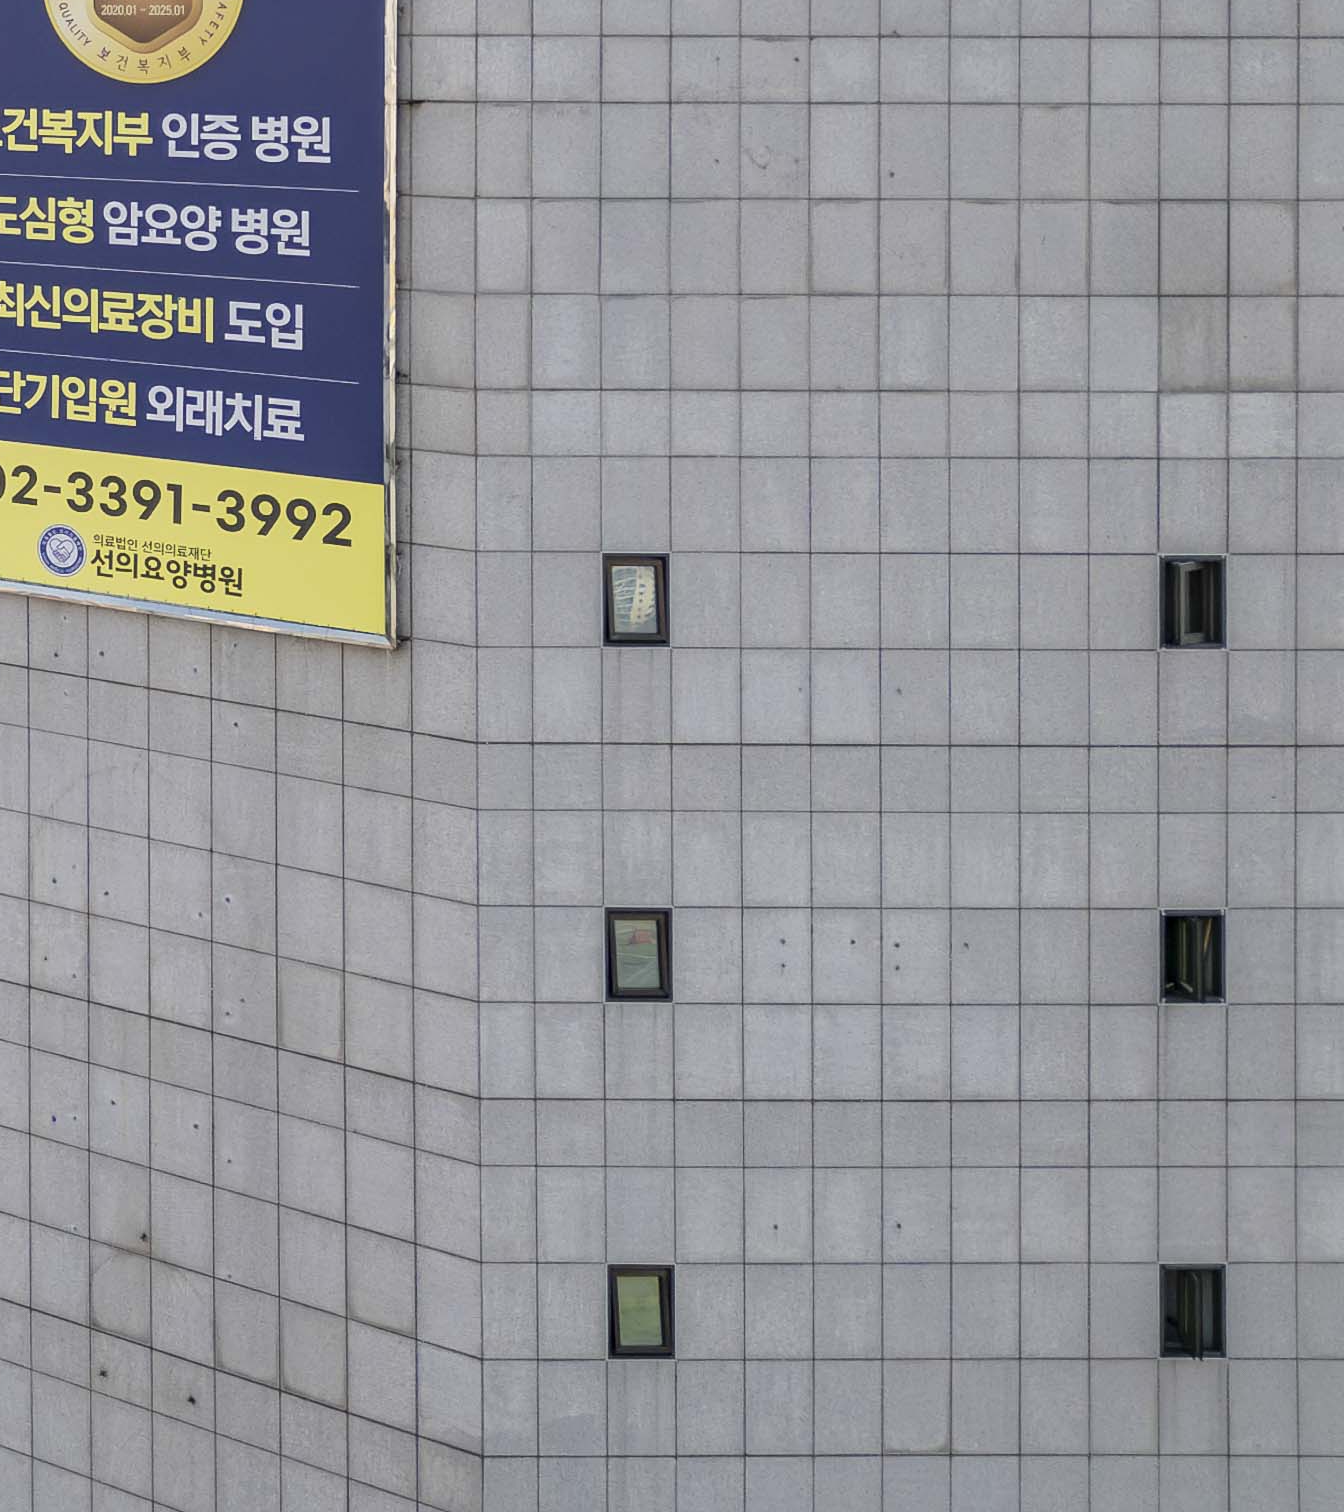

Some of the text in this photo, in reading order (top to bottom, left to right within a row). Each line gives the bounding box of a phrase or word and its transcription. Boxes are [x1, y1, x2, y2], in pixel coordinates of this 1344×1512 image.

[58, 1, 92, 47] QUALITY
[161, 113, 242, 161] 인증
[251, 115, 332, 164] 병원
[103, 201, 222, 253] 암요양
[231, 208, 311, 257] 병원
[224, 300, 304, 351] 도입
[146, 386, 305, 442] 외래치료
[93, 534, 138, 552] 의료법인
[142, 540, 212, 562] 선의의료재단
[91, 550, 243, 598] 선의요양병원
